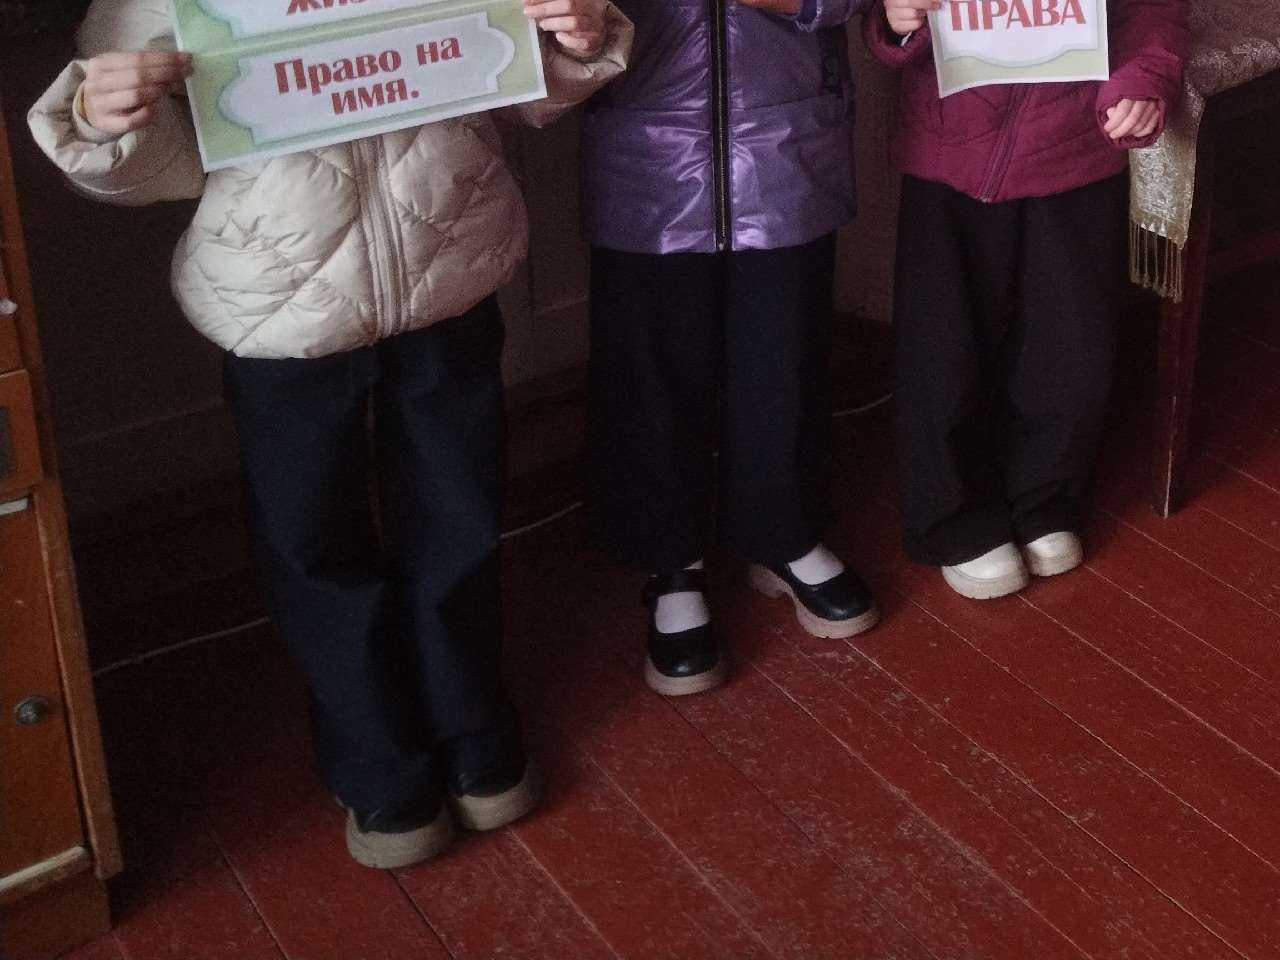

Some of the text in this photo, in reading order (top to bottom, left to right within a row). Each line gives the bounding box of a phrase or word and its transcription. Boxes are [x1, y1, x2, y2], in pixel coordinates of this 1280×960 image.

[275, 37, 463, 95] Право на
[331, 78, 420, 115] имя.
